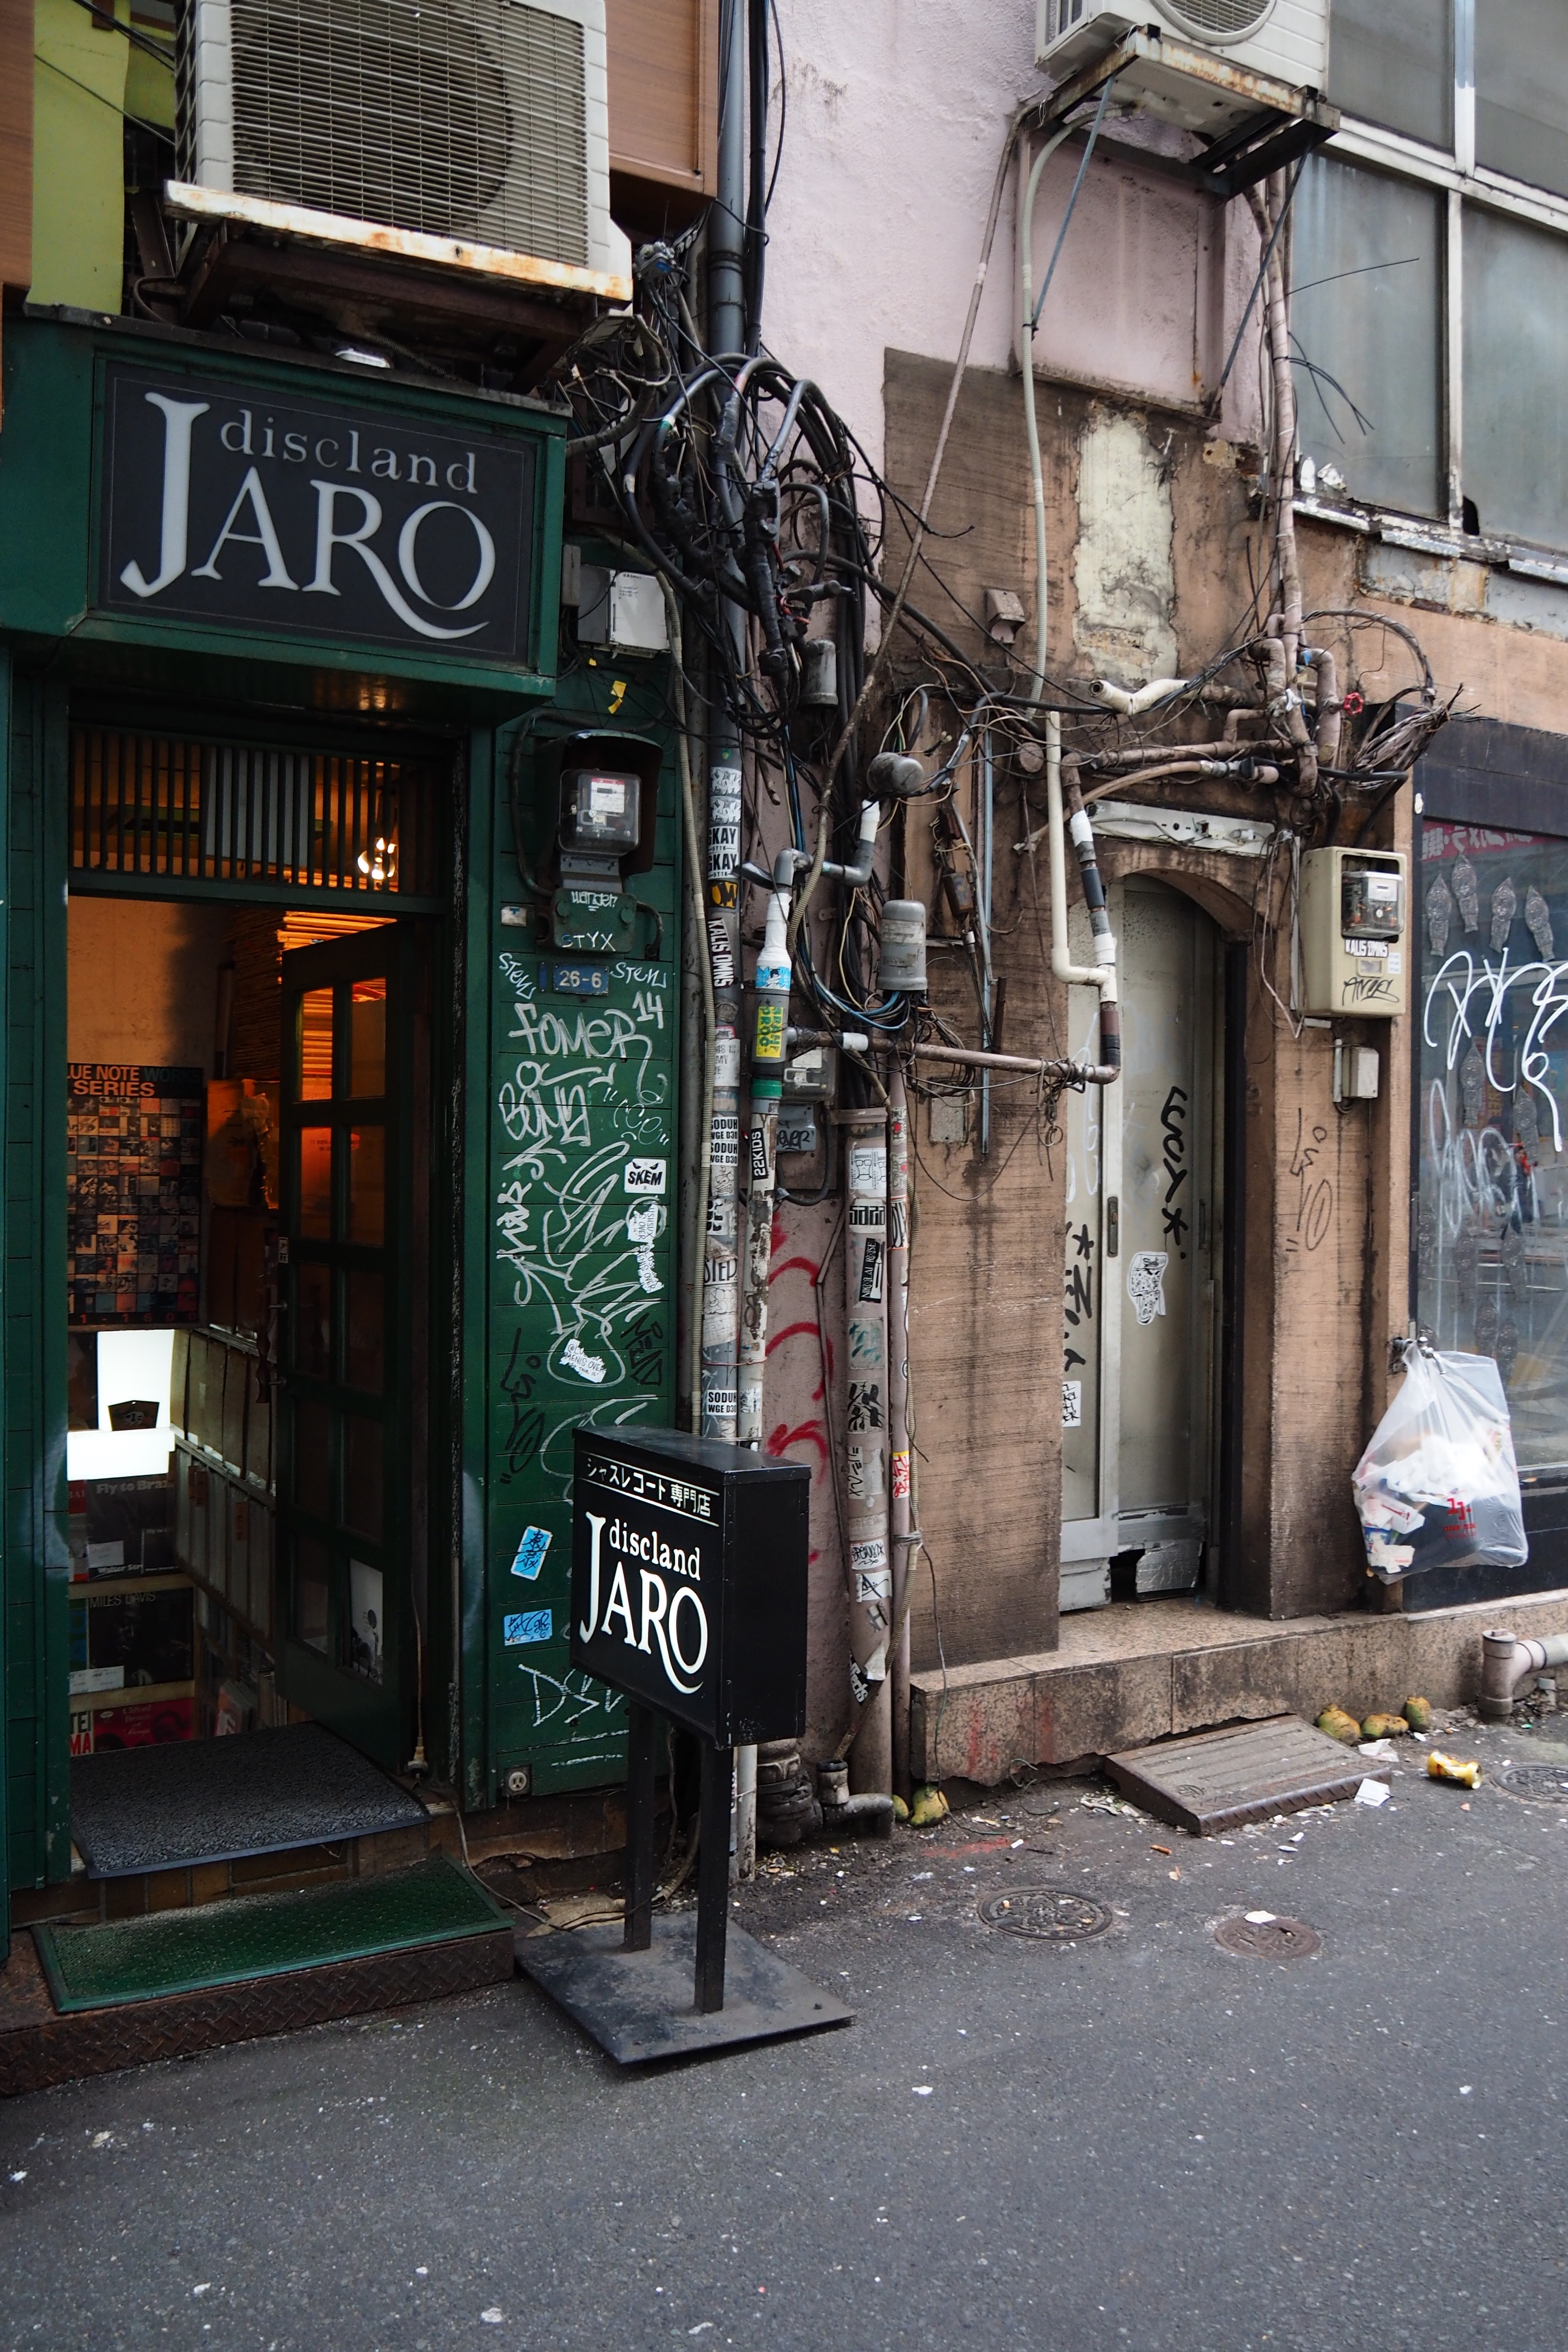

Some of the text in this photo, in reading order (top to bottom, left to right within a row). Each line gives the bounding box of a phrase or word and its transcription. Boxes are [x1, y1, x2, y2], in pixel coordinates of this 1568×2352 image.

[220, 409, 478, 494] discland
[119, 392, 496, 639] JARO
[708, 919, 730, 952] KALIS
[559, 970, 602, 989] 26-6
[67, 1065, 92, 1080] UE
[96, 1066, 139, 1081] NOTE
[74, 1080, 155, 1097] SERIES
[752, 1131, 766, 1176] 22KIDS
[628, 1170, 663, 1186] SKEM
[861, 1266, 873, 1298] NIKOLAI
[708, 1405, 724, 1413] WGE
[96, 1484, 117, 1495] Fly
[119, 1482, 135, 1491] to
[609, 1518, 701, 1581] discland
[89, 1591, 156, 1609] MILES DAVIS
[579, 1511, 708, 1694] JARO
